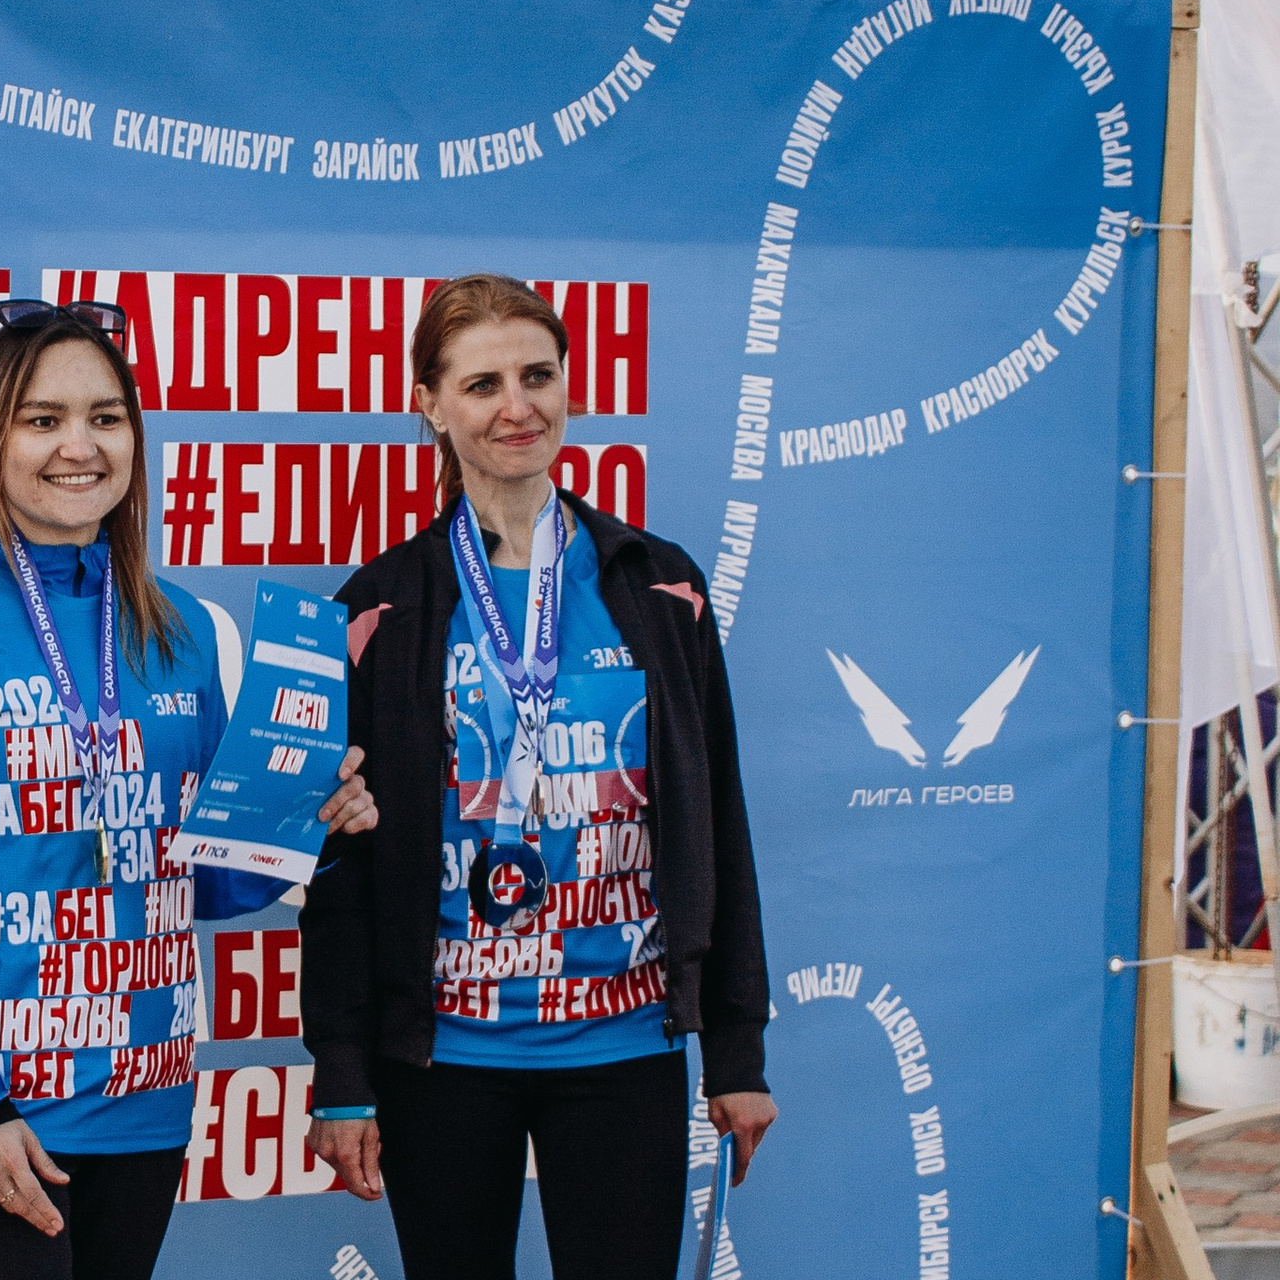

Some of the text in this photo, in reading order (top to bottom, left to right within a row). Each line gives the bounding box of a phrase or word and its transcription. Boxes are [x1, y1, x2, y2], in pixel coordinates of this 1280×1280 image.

[1040, 3, 1114, 95] КЫЗЫЛ
[112, 108, 295, 175] ЕКАТЕРИНБУРГ
[312, 137, 420, 182] ЗАРАЙСК
[439, 122, 543, 180] ИЖЕВСК
[553, 46, 656, 147] ИРКУТСК
[776, 80, 843, 188] МАЙКОП
[1095, 101, 1133, 187] КУРСК
[745, 202, 799, 355] МАХАЧКАЛА
[1053, 207, 1130, 334] КУРИЛЬСК
[920, 328, 1059, 434] КРАСНОЯРСК
[731, 374, 773, 480] МОСКВА
[780, 408, 907, 466] КРАСНОДАР
[12, 534, 72, 696] САХАЛИНСКАЯ ОБЛАСТЬ
[456, 515, 510, 651] САХАЛИНСКАЯ ОБЛАСТЬ
[104, 605, 115, 699] САХАЛИНСКАЯ
[277, 687, 330, 732] МЕСТО
[542, 720, 607, 768] 016
[284, 747, 308, 776] КМ
[848, 784, 1014, 807] ЛИГА ГЕРОЕВ
[206, 846, 230, 859] ПСБ
[249, 853, 284, 867] FONBET
[145, 878, 194, 935] #МО
[38, 933, 196, 997] #ГОРДОСТЬ
[787, 963, 862, 1004] ПЕРМЬ
[866, 984, 932, 1094] ОРЕНБУРГ
[908, 1105, 946, 1175] ОМСК
